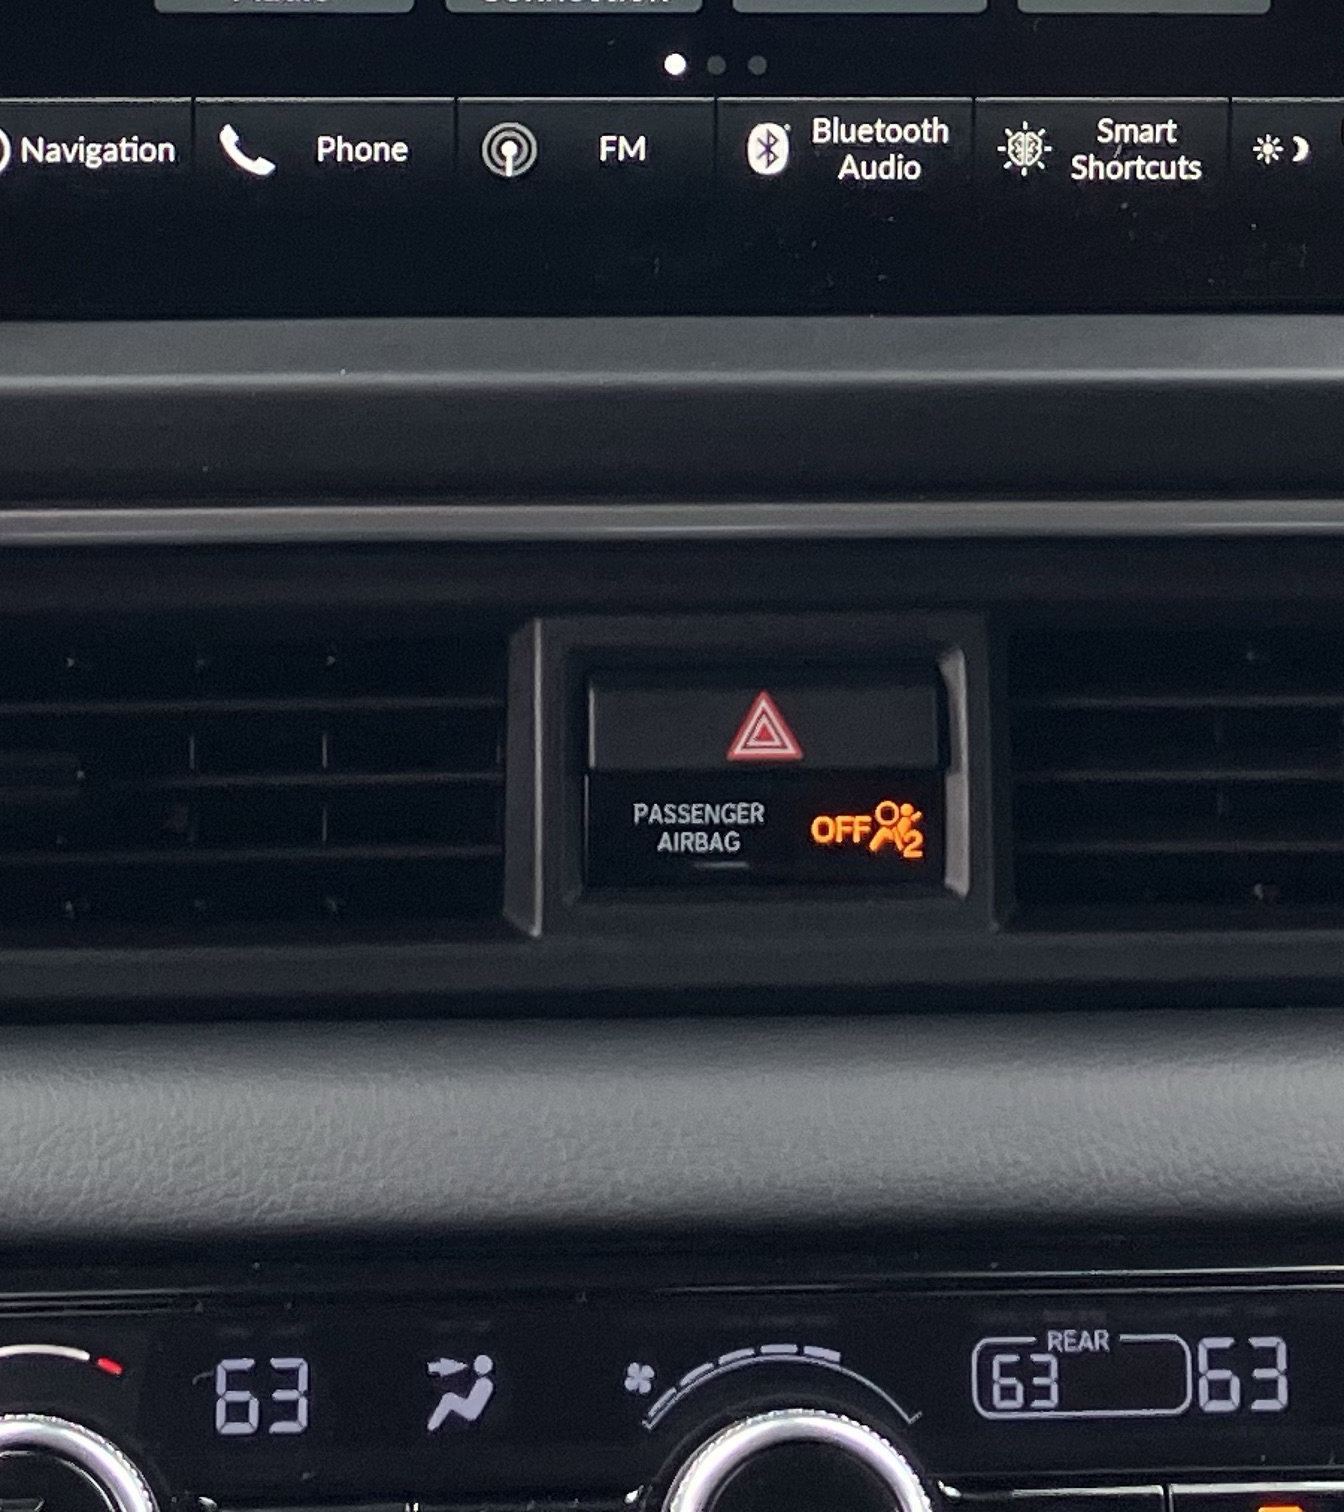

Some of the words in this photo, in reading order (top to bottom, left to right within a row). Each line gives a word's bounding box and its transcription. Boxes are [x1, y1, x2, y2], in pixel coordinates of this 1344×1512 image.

[812, 116, 949, 144] Bluetooth
[1097, 117, 1178, 144] Smart
[21, 135, 176, 169] Navigation
[317, 135, 409, 163] Phone
[599, 135, 646, 162] FM
[837, 153, 922, 180] Audio
[1070, 152, 1203, 181] Shortcuts
[632, 801, 765, 825] PASSENGER
[656, 830, 741, 853] AIRBAG
[810, 815, 872, 846] OFF
[1046, 1328, 1111, 1354] REAR
[990, 1353, 1061, 1410] 63
[1197, 1336, 1288, 1413] 63
[215, 1357, 309, 1435] 63
